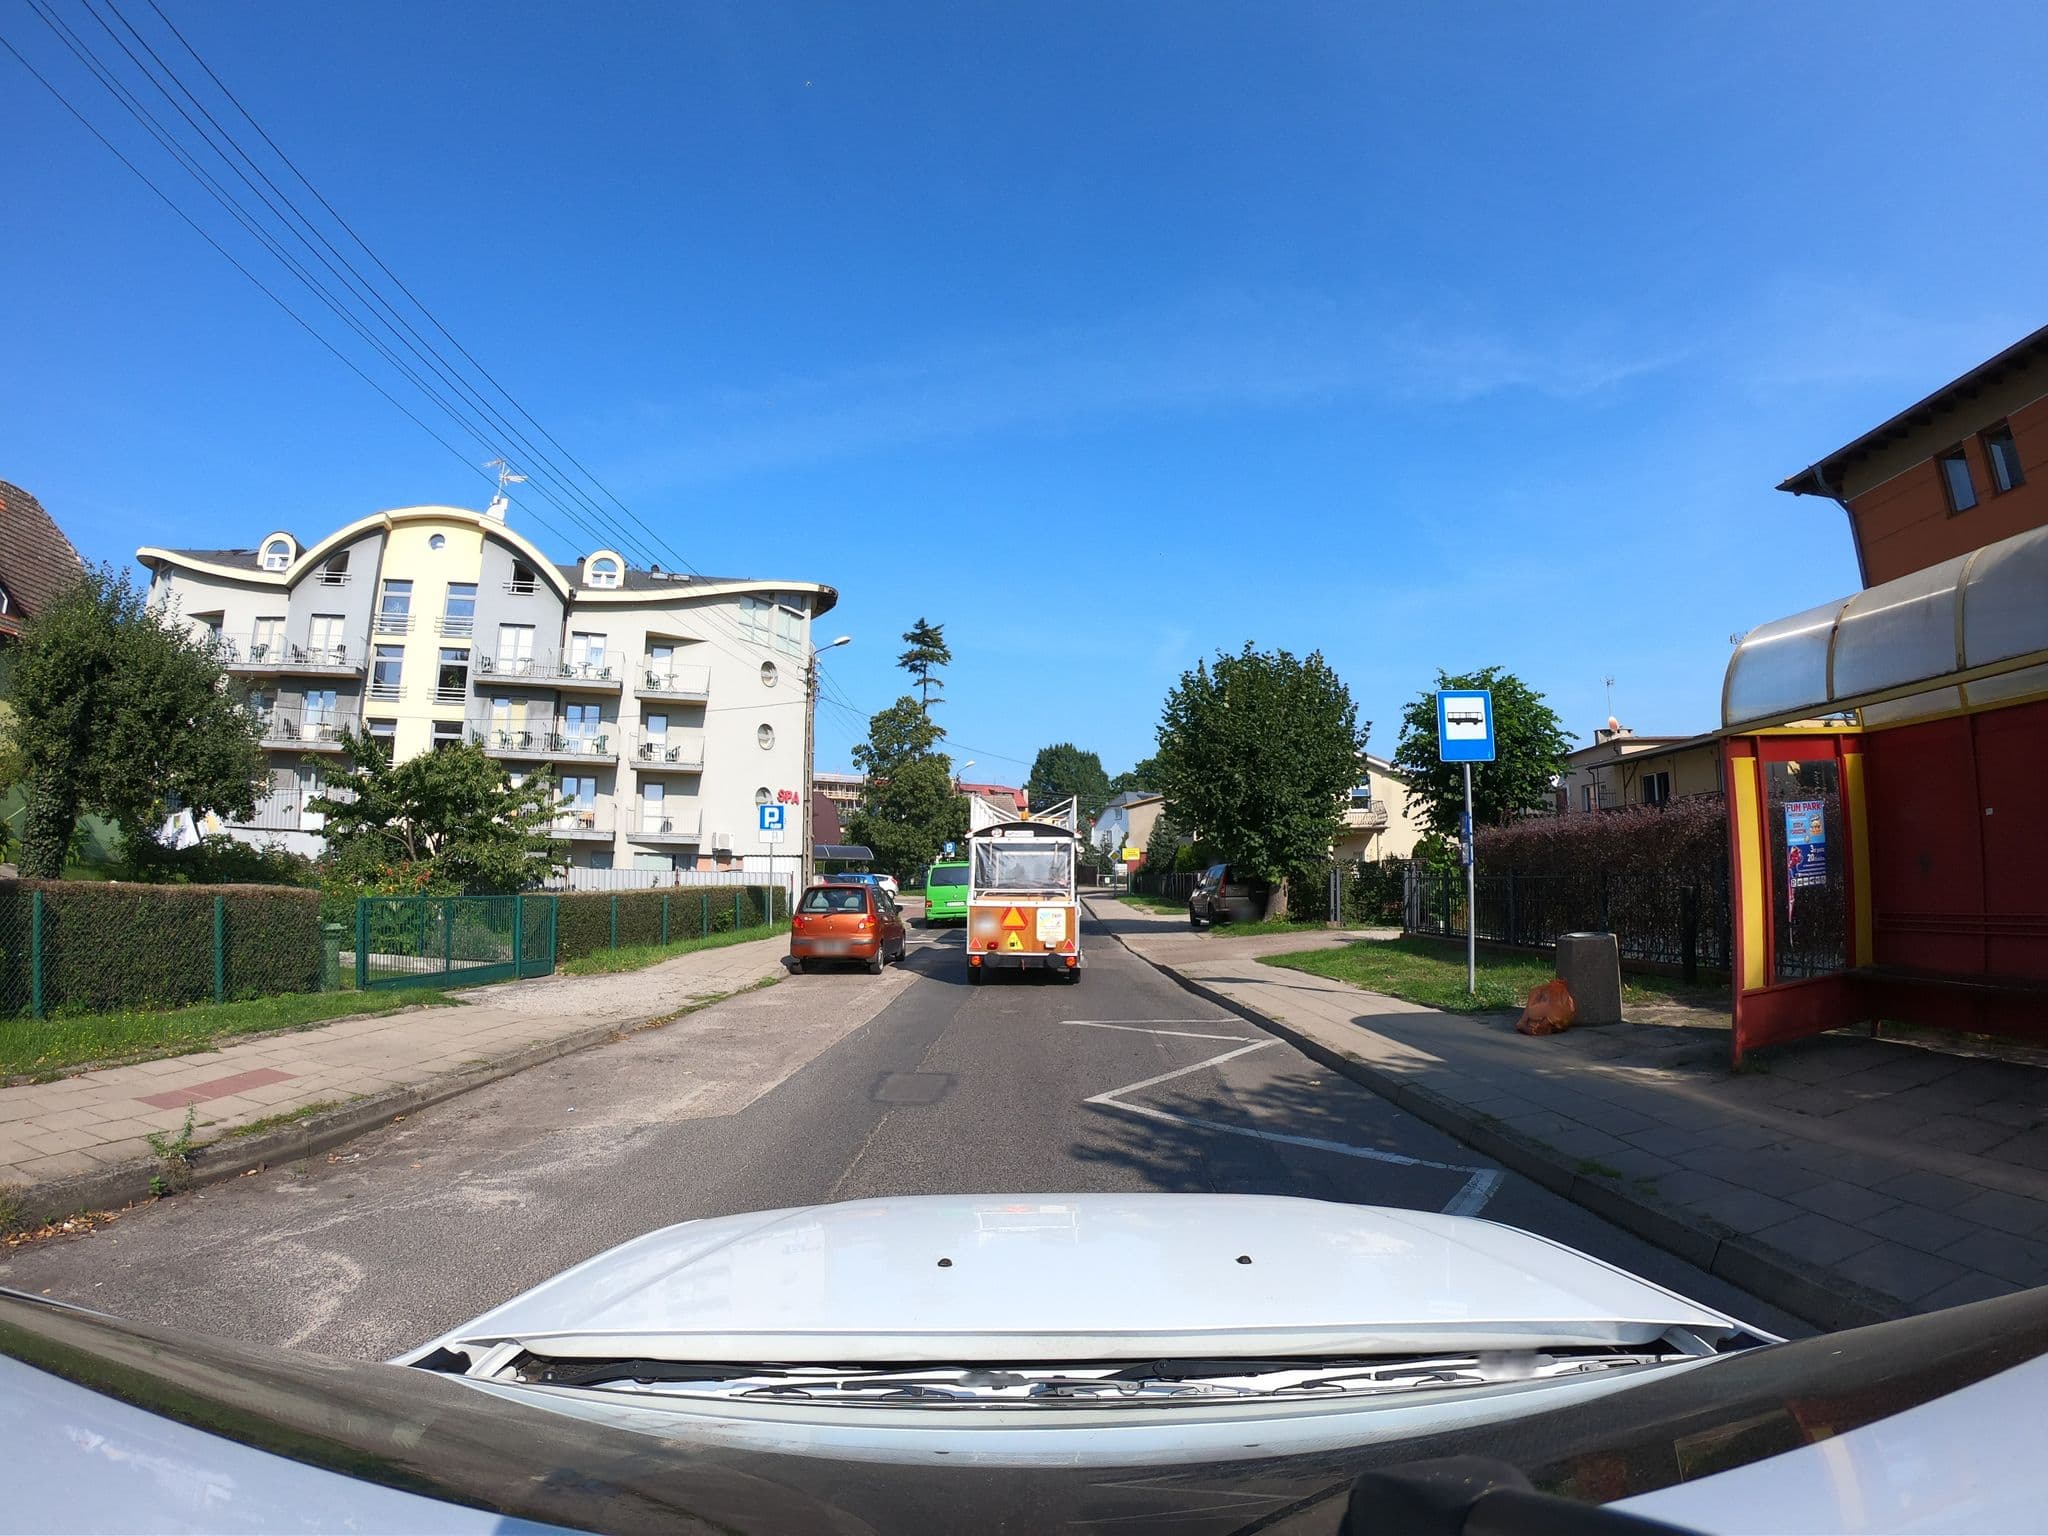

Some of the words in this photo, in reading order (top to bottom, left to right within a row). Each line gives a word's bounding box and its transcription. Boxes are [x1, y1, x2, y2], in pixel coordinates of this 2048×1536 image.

[777, 789, 799, 805] SPA
[1785, 803, 1802, 812] FUN
[1803, 801, 1822, 811] PARK
[764, 807, 780, 828] P
